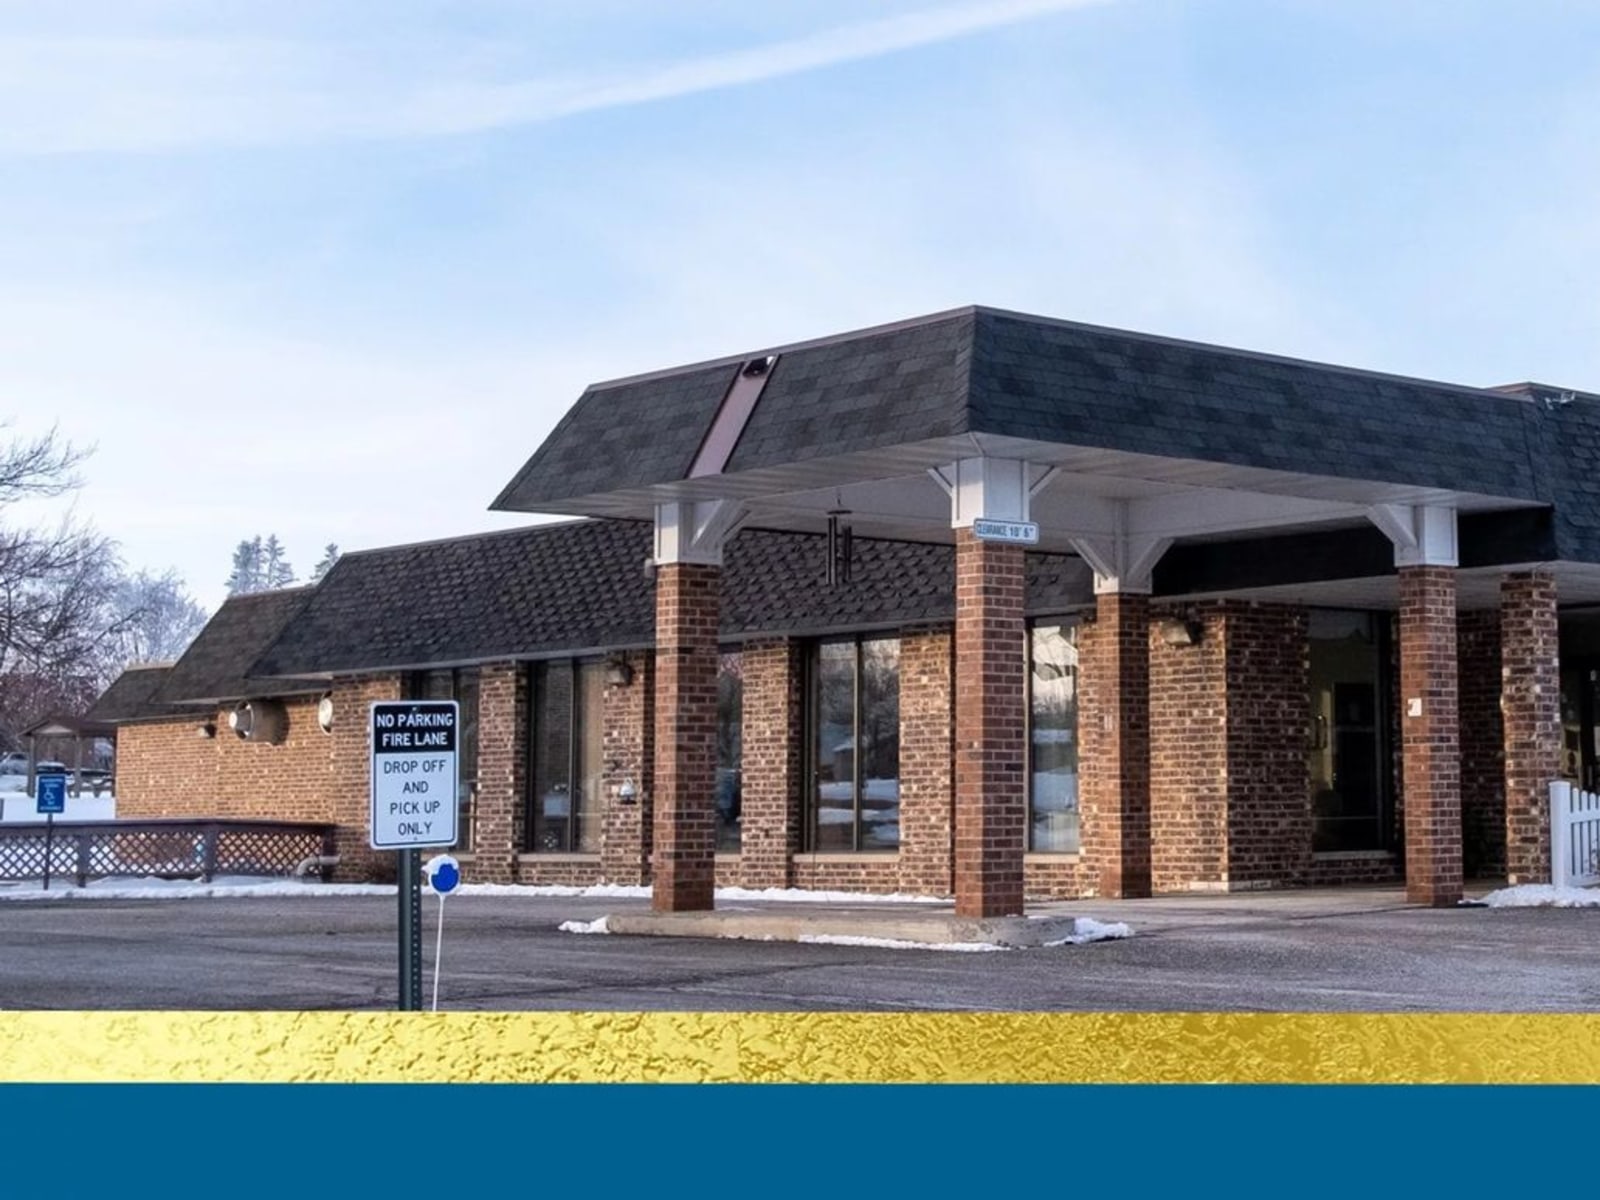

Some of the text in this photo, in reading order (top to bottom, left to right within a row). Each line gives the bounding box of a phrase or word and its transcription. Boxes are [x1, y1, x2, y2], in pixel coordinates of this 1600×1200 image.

[376, 713, 454, 728] NO PARKING
[382, 732, 448, 747] FIRE LANE
[384, 759, 447, 774] DROP OFF
[402, 781, 429, 794] AND
[390, 801, 440, 815] PICK UP
[398, 822, 433, 836] ONLY
